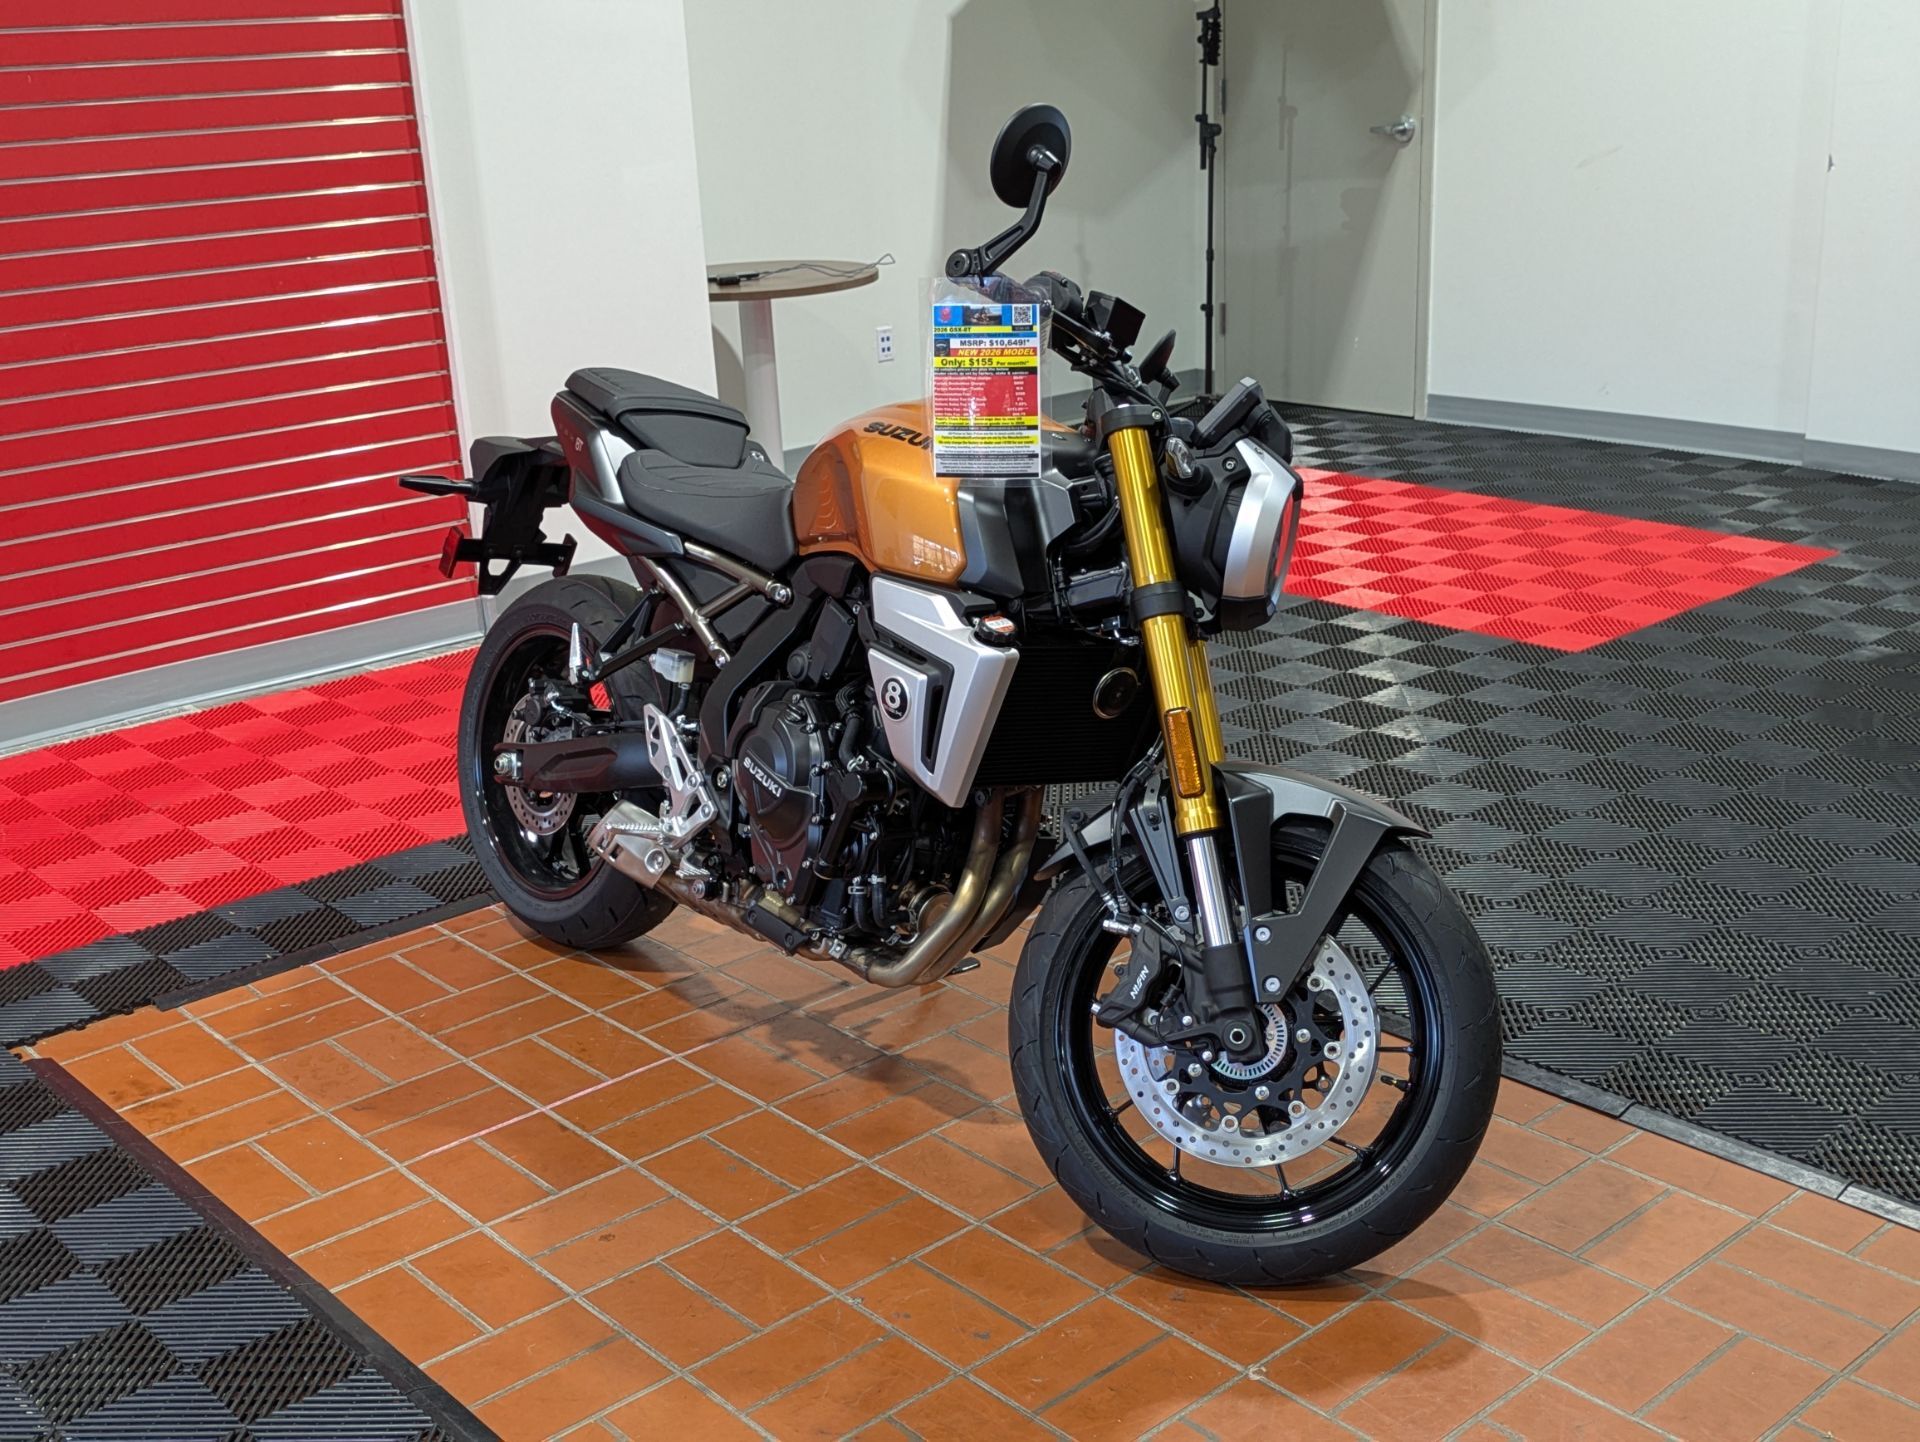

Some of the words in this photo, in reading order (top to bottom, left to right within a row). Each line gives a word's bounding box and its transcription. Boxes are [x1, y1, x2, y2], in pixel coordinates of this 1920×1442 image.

[941, 358, 965, 368] Only:
[968, 358, 993, 367] $155
[1003, 348, 1035, 356] MODEL
[863, 421, 932, 450] SUZU
[885, 681, 901, 709] 8
[743, 757, 782, 797] SUZUKI
